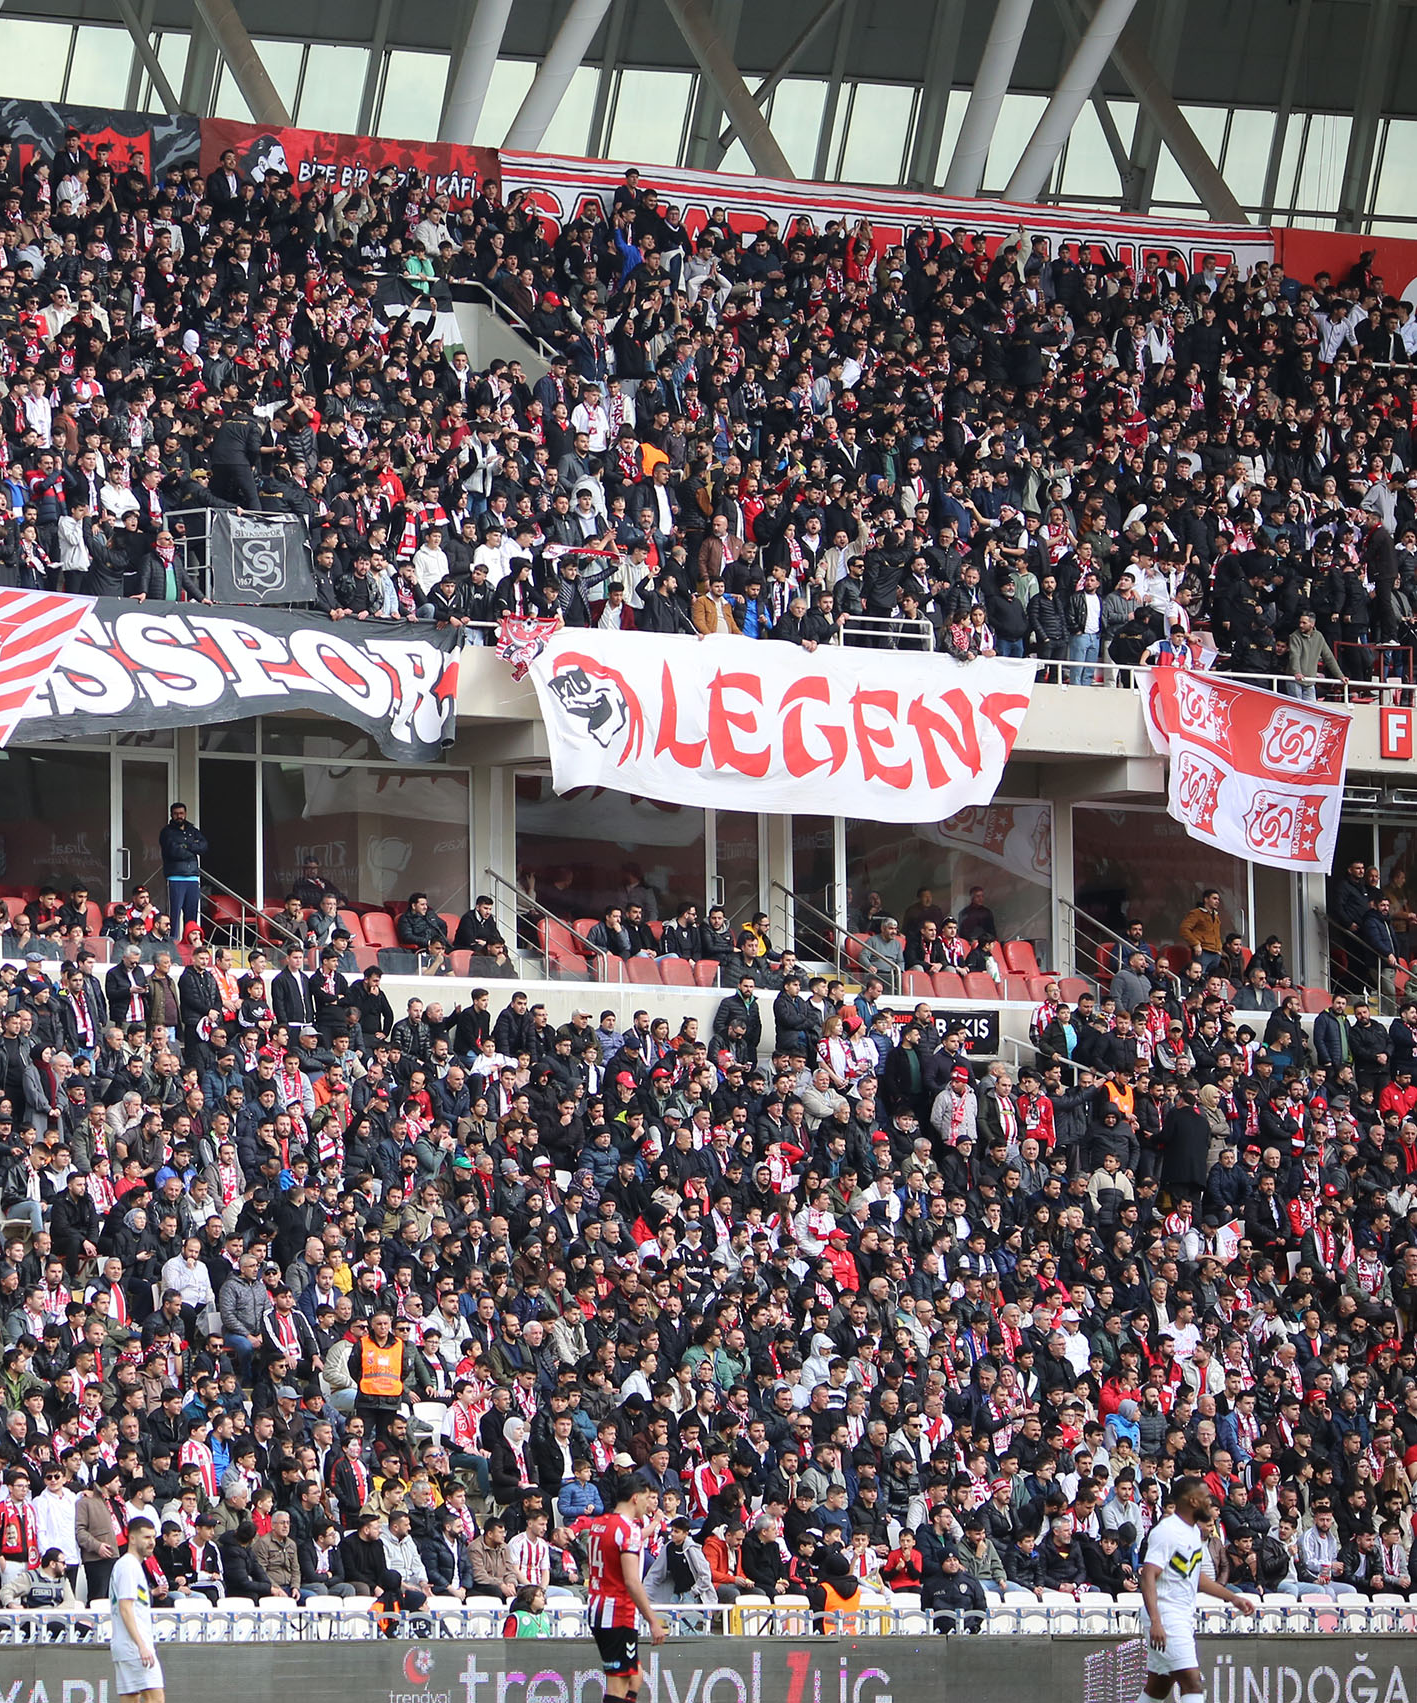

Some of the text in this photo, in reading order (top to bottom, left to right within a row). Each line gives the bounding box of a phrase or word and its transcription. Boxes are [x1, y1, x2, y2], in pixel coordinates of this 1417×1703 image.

[1388, 713, 1407, 752] F
[1292, 799, 1307, 856] SİVASSPOR
[935, 1017, 990, 1039] BKIŞ
[588, 1535, 604, 1577] 14
